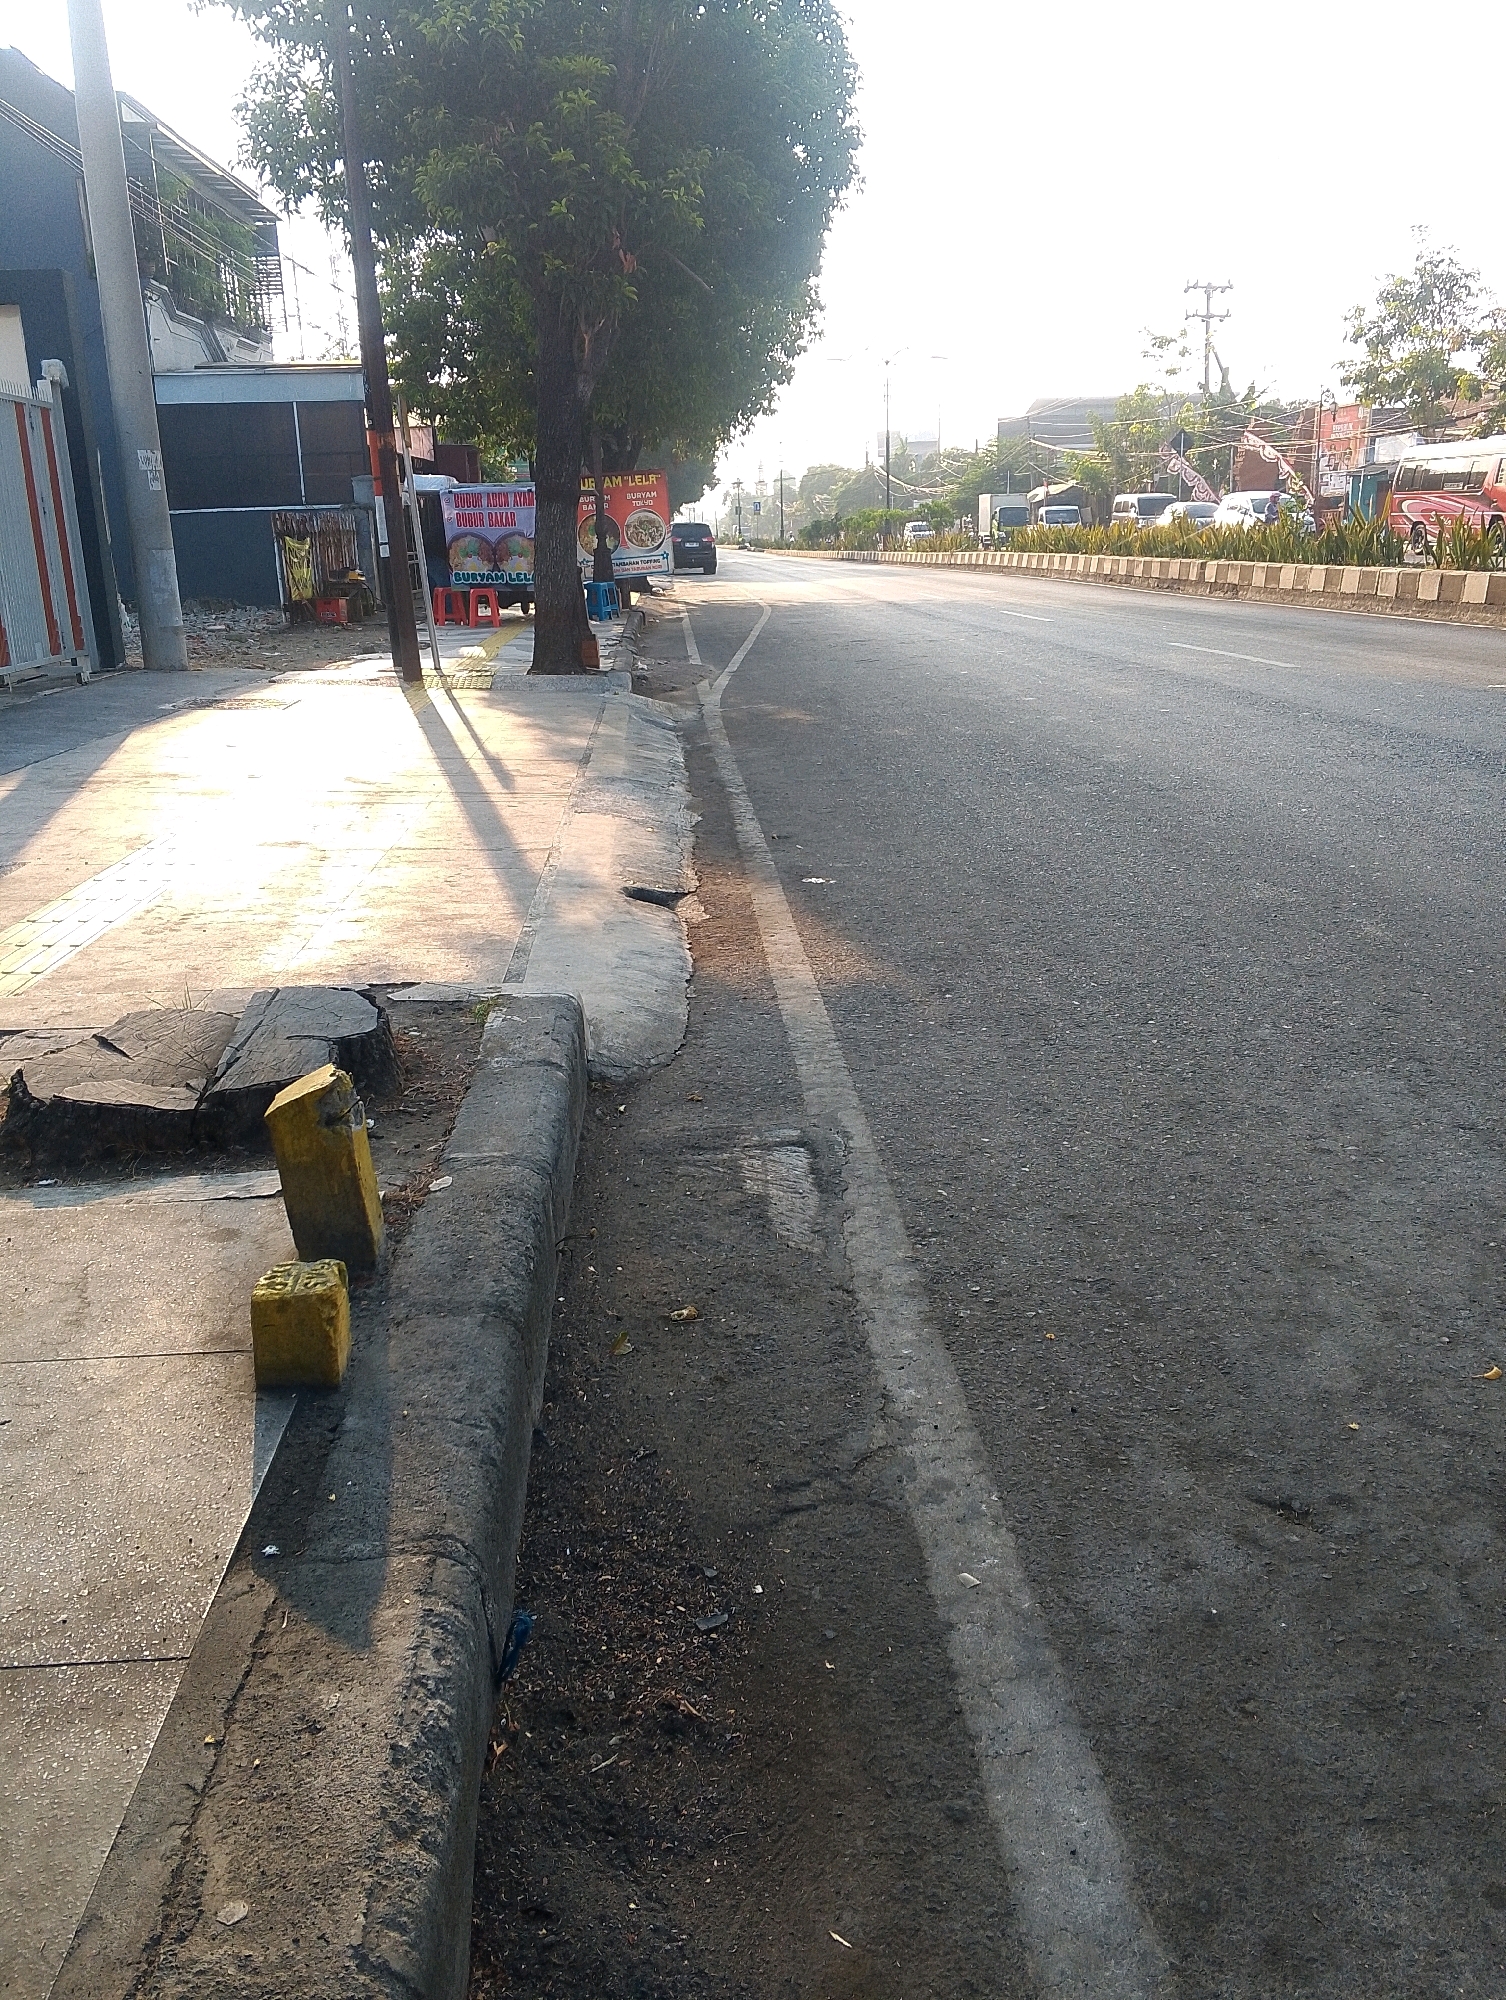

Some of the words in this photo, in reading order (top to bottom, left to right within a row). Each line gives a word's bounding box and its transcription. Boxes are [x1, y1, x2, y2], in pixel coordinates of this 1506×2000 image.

[453, 492, 483, 509] BUBUR
[486, 491, 510, 508] ABON
[513, 491, 535, 508] AYAM
[580, 494, 610, 503] BURM
[627, 491, 657, 500] BURYAM
[455, 511, 486, 528] BUBUR
[487, 511, 517, 527] BAKAR
[453, 571, 505, 583] BURYAM
